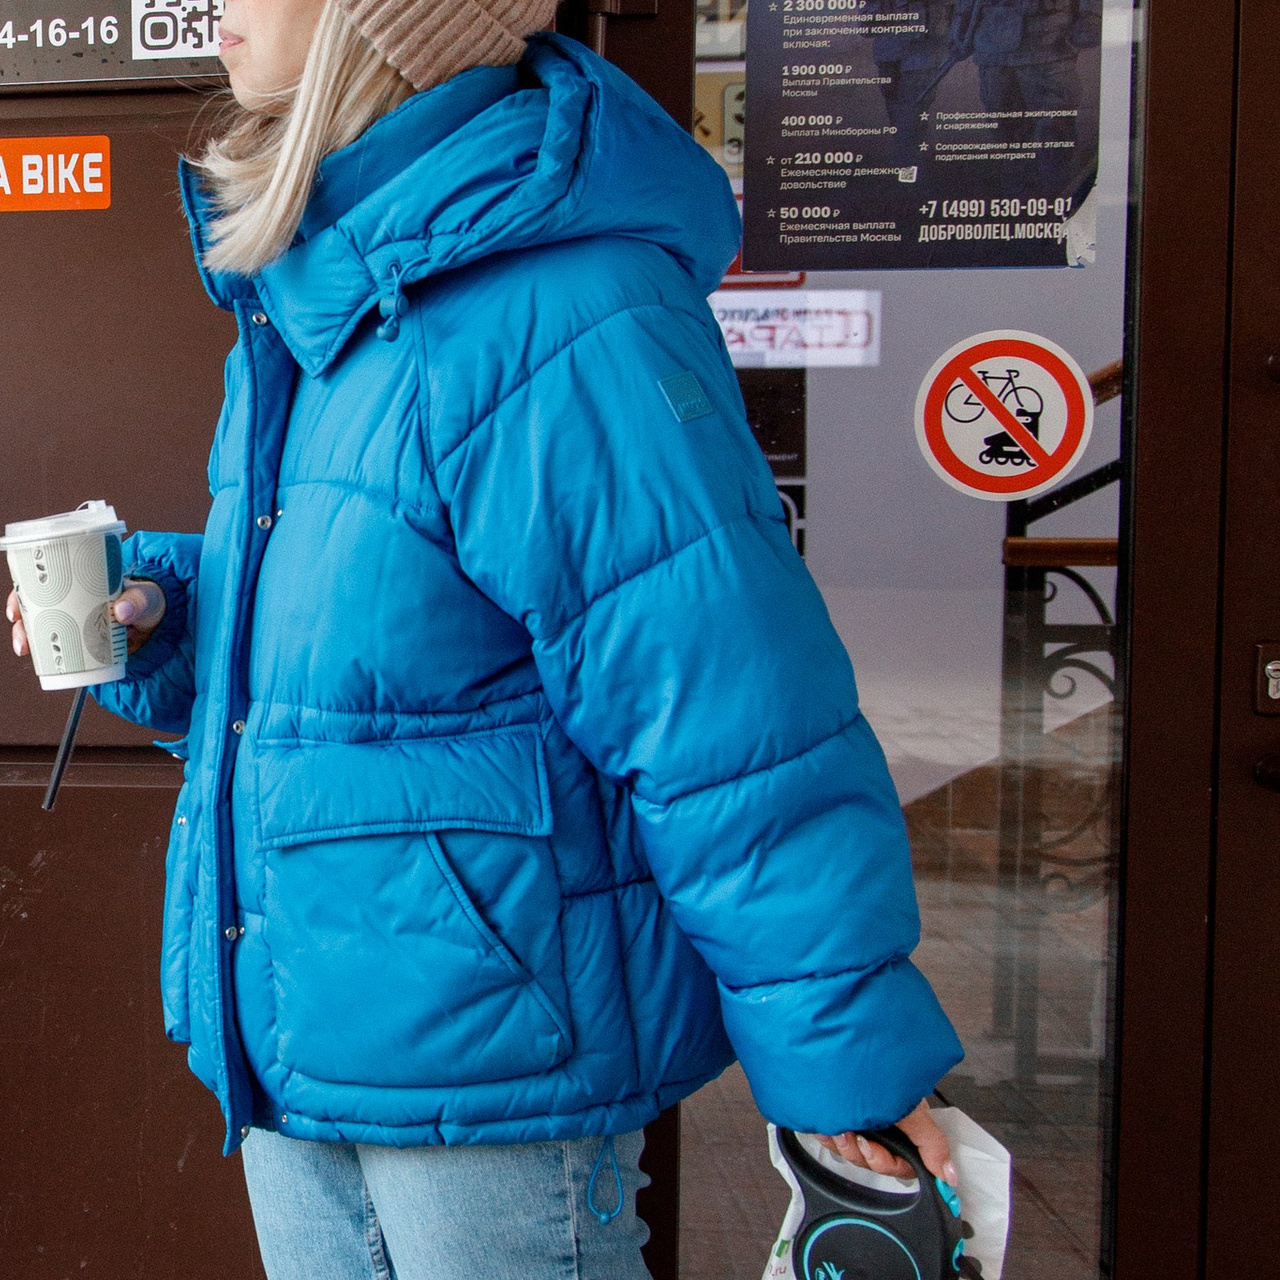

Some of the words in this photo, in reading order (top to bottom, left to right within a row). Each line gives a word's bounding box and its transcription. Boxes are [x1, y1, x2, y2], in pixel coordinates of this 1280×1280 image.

[783, 0, 793, 12] 2
[783, 13, 873, 24] Единовременная
[875, 12, 920, 22] выплата
[783, 28, 803, 38] при
[804, 26, 869, 36] заключении
[871, 24, 929, 35] контракта,
[782, 39, 831, 49] включая:
[791, 64, 816, 75] 900
[818, 64, 843, 74] 000
[782, 78, 821, 87] Выплата
[822, 76, 892, 87] Правительства
[782, 89, 818, 98] Москвы
[936, 110, 1023, 120] Профессиональная
[1024, 109, 1078, 119] экипировка
[781, 116, 806, 126] 400
[808, 115, 833, 125] 000
[943, 121, 999, 131] снаряжение
[781, 128, 820, 138] Выплата
[821, 126, 881, 137] Минобороны
[882, 126, 898, 135] РФ
[935, 141, 1008, 152] Сопровождение
[1022, 141, 1043, 149] всех
[1044, 140, 1075, 149] этапах
[780, 157, 793, 165] от
[794, 153, 822, 165] 210
[824, 152, 854, 164] 000
[935, 152, 988, 162] подписания
[989, 151, 1036, 161] контракта
[21, 152, 104, 195] BIKE
[780, 168, 852, 178] Ежемесячное
[779, 180, 847, 191] довольствие
[779, 207, 799, 218] 50
[801, 206, 831, 218] 000
[919, 200, 938, 218] +7
[942, 199, 986, 218] (499)
[779, 222, 850, 231] Ежемесячная
[852, 221, 896, 230] выплата
[779, 234, 858, 245] Правительства
[860, 233, 902, 242] Москвы
